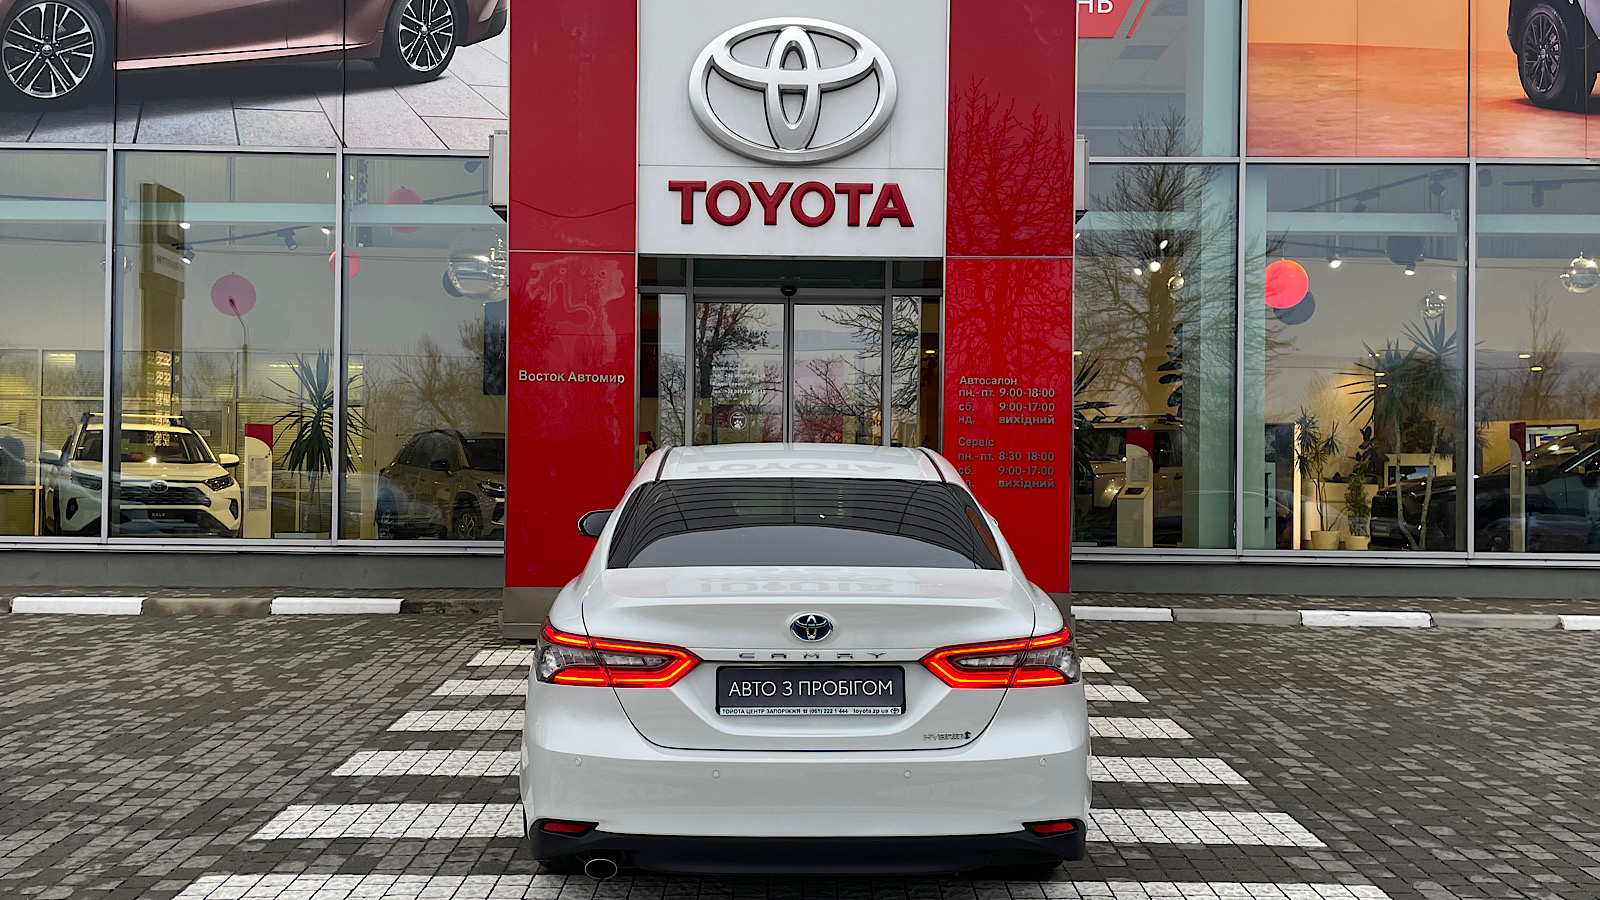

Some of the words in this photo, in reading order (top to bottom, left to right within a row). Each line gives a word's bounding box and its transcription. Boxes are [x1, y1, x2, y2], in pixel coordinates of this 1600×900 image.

[668, 179, 914, 228] TOYOTA
[518, 370, 565, 382] Восток
[567, 371, 625, 386] Автомир
[959, 376, 1018, 386] Автосалон
[959, 402, 976, 412] сб.
[999, 402, 1056, 412] 9:00-17:00
[958, 416, 976, 425] нд.
[999, 413, 1056, 426] вихідний
[958, 437, 995, 449] Сервіс
[958, 465, 975, 475] сб.
[998, 466, 1055, 476] 9:00-17:00
[998, 478, 1055, 490] вихідний
[728, 681, 777, 697] АВТО
[798, 680, 893, 697] ПРОБІГОМ
[746, 708, 765, 716] ЦЕНТР
